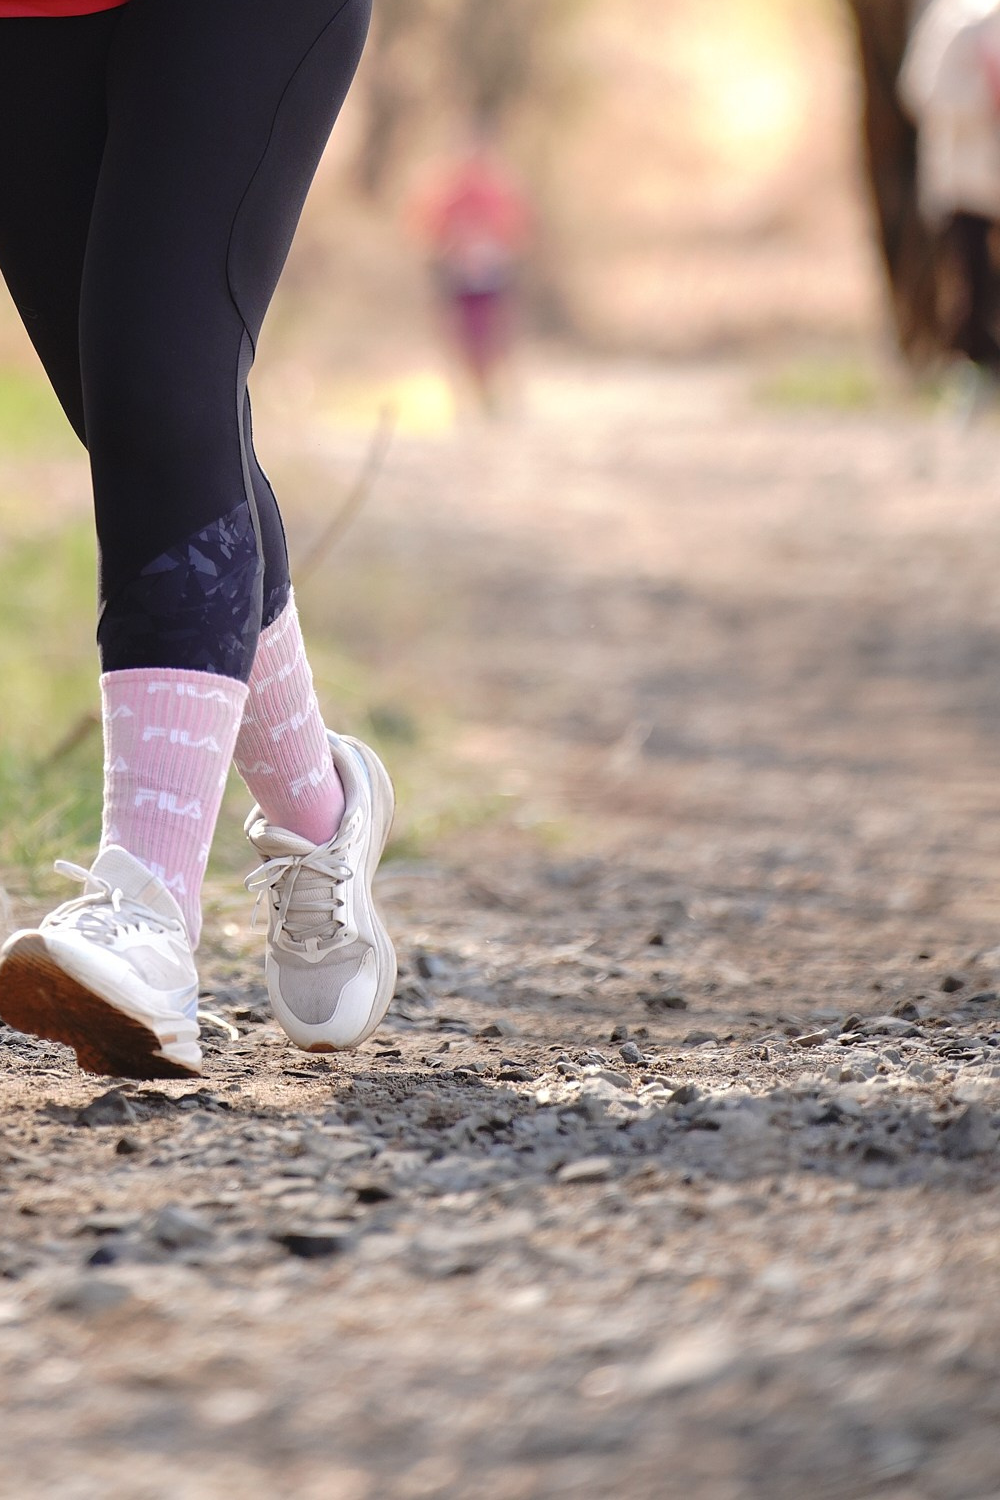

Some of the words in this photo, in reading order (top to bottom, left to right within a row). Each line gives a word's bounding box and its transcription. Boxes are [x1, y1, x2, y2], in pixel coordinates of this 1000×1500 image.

[147, 681, 232, 705] FILA
[142, 725, 222, 753] FILA
[134, 787, 202, 820] FILA
